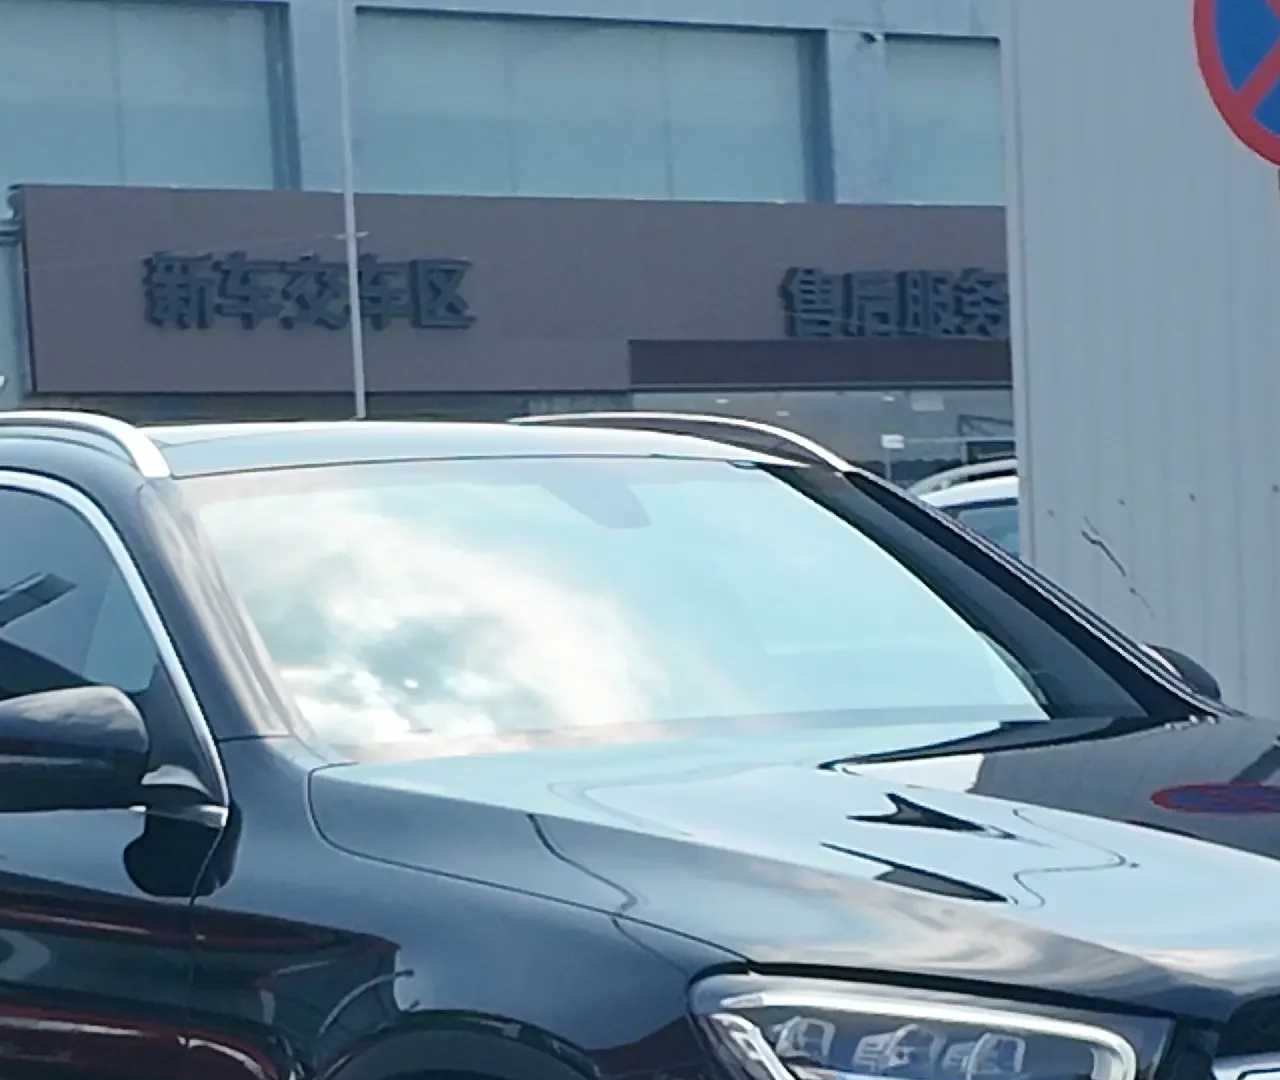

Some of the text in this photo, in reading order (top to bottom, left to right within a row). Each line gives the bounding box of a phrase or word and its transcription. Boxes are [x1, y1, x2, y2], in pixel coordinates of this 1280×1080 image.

[141, 251, 477, 331] 新车交车区
[777, 266, 1010, 340] 售后服务
